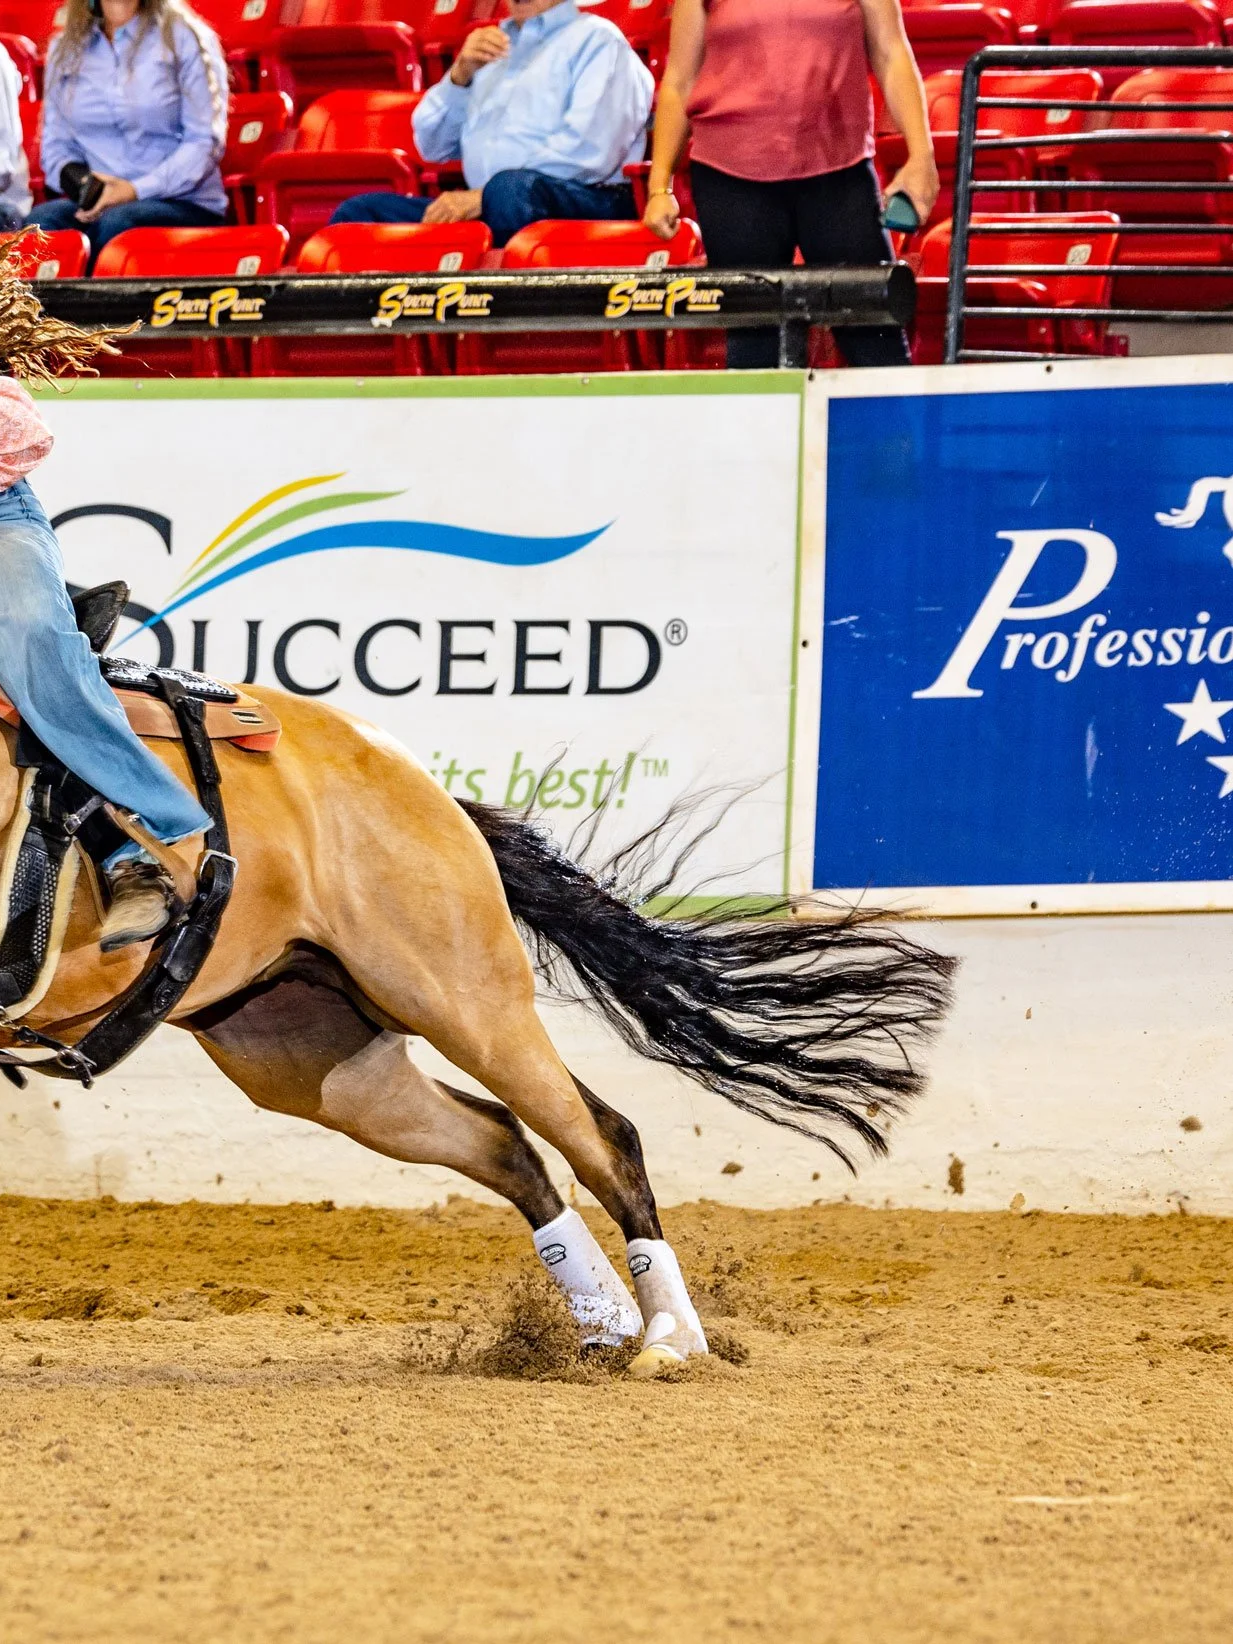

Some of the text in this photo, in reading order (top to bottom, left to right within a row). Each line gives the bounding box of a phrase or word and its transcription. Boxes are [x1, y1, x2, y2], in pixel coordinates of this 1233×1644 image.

[151, 287, 266, 328] SOUTH POINT
[379, 282, 493, 322] SOUTH POINT
[605, 277, 724, 318] SOUTH POINT
